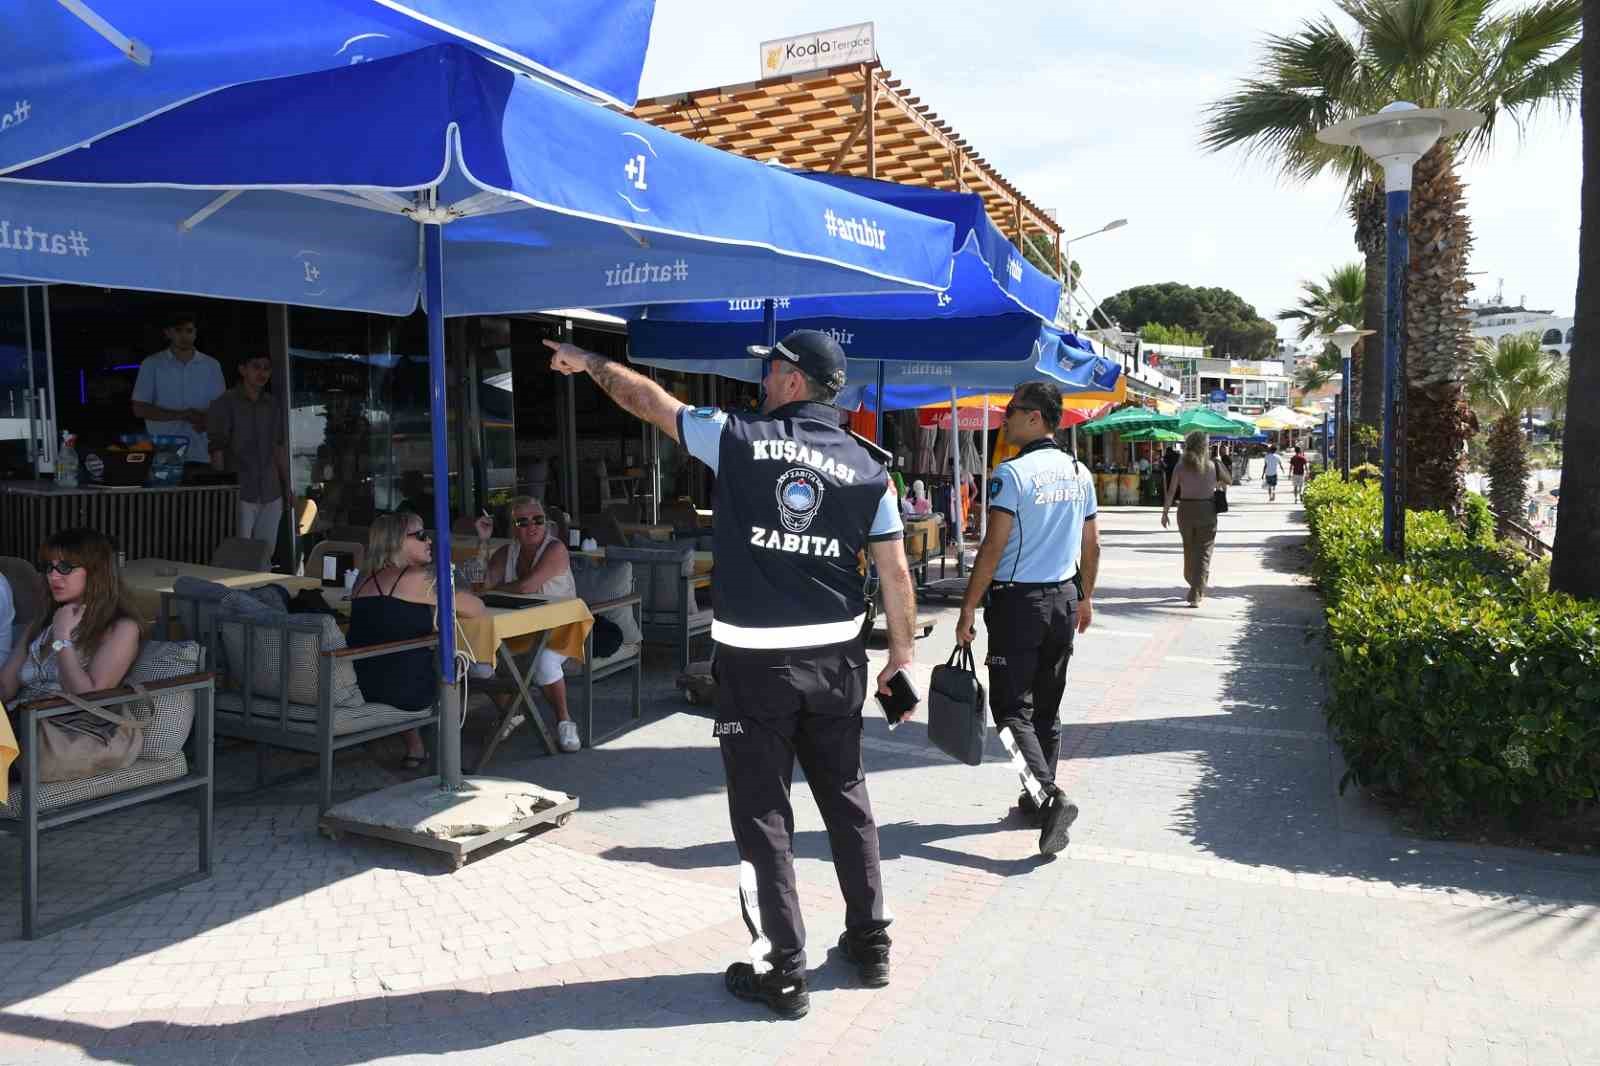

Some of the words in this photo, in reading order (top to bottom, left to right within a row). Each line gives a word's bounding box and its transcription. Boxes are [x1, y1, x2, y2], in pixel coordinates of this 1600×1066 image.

[785, 37, 831, 60] Koala
[832, 38, 870, 50] Terrace
[624, 154, 648, 191] +1
[750, 526, 840, 557] ZABITA
[715, 721, 745, 736] ZABITA
